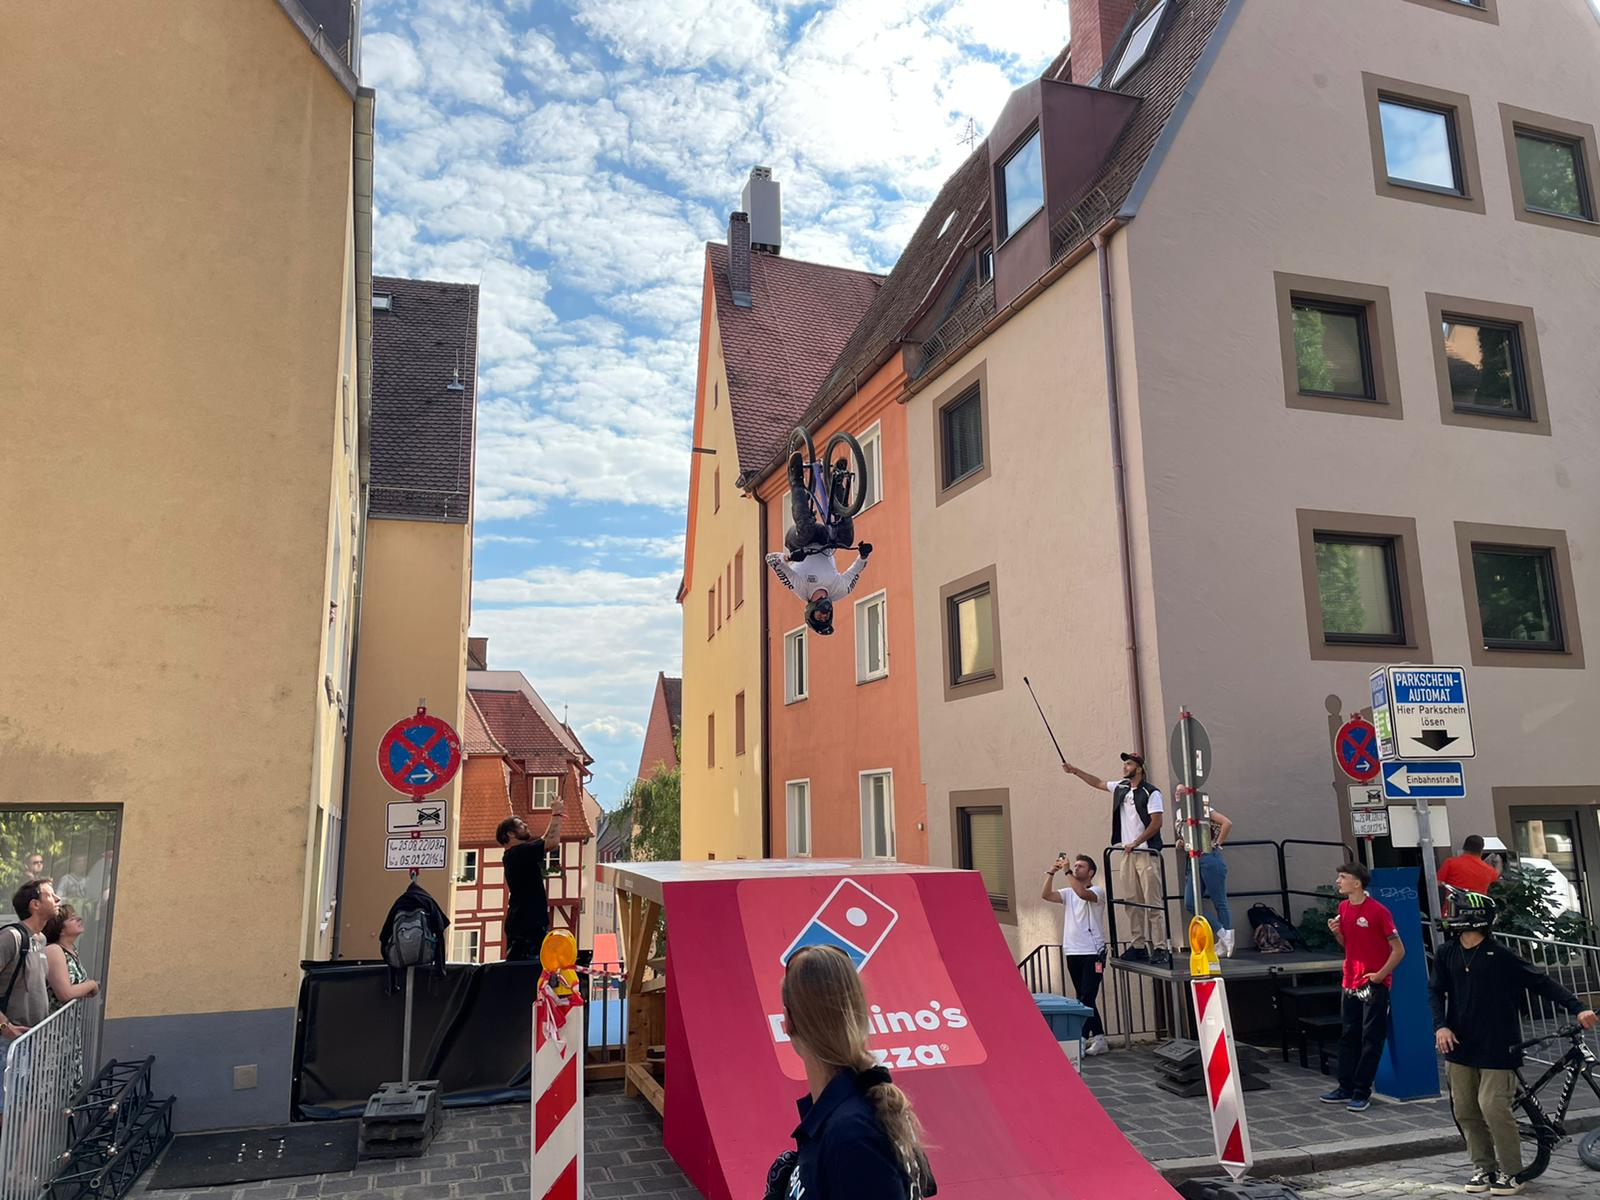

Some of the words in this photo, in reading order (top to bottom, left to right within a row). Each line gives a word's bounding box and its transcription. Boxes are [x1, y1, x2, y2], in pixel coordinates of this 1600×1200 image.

[1395, 671, 1460, 687] PARKSCHEIN-
[1408, 688, 1451, 702] AUTOMAT
[1396, 705, 1415, 715] Hier
[1419, 705, 1466, 715] Parkschein
[1421, 717, 1446, 727] lösen
[1406, 775, 1460, 785] Einbahnstraße
[768, 1000, 968, 1043] Dino's
